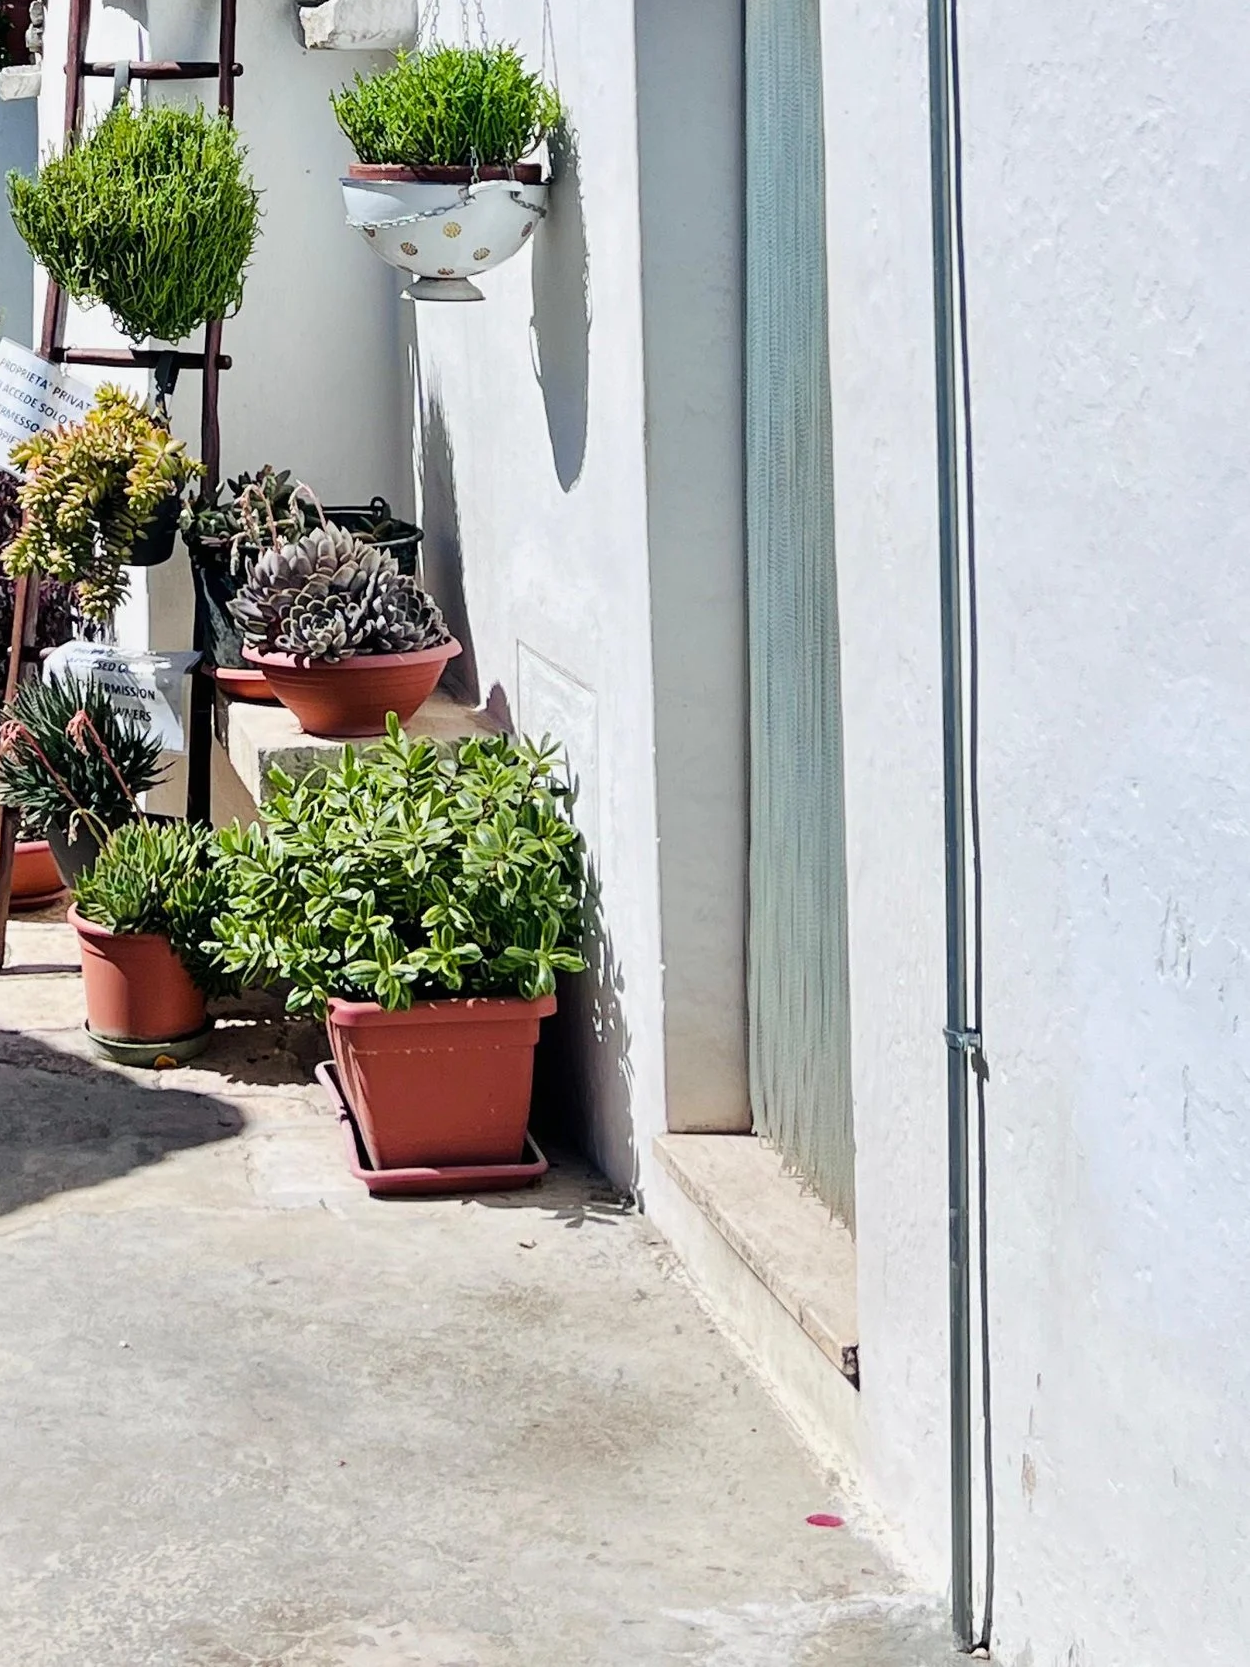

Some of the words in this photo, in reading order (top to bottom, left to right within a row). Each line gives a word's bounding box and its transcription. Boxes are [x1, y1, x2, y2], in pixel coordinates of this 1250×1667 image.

[1, 384, 39, 409] ACCEDE
[37, 402, 68, 425] SOLO
[52, 385, 93, 411] PRIVAT
[94, 679, 156, 701] RMISSION
[112, 705, 152, 723] WNERS
